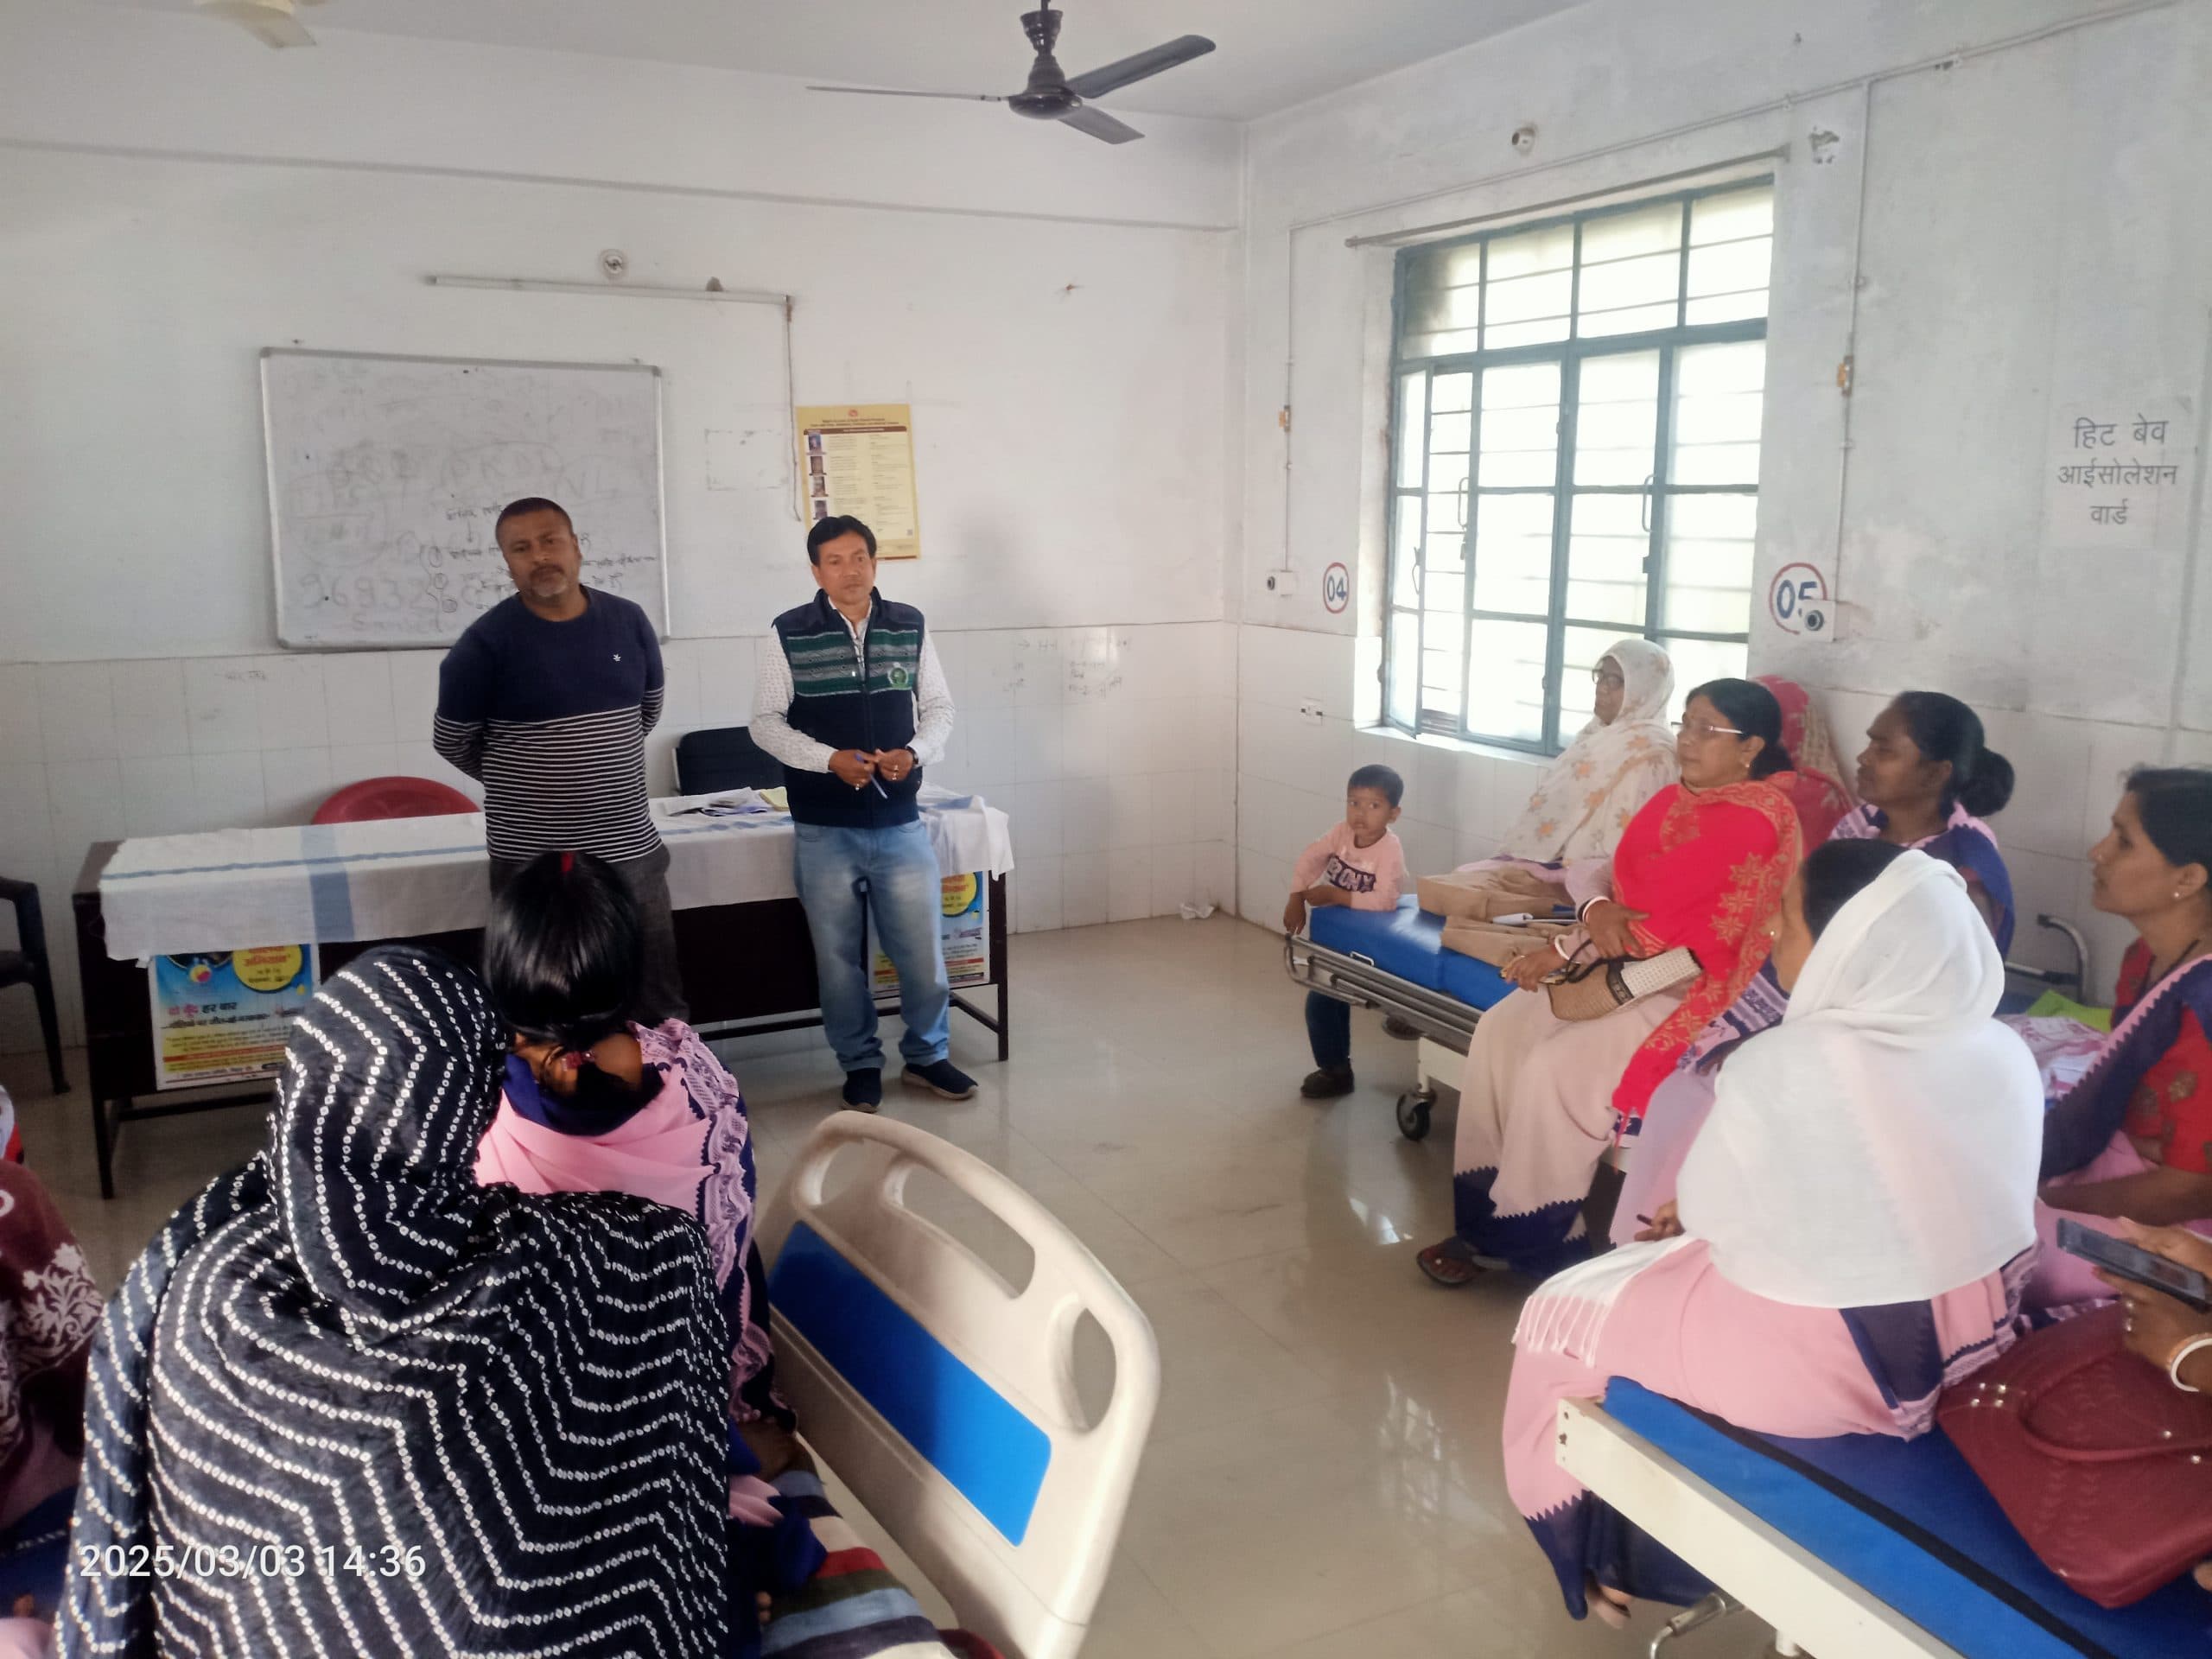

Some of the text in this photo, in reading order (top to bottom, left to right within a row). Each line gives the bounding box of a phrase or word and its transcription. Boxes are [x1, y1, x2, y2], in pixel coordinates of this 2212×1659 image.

[2072, 413, 2169, 449] हिट बेव
[2057, 457, 2178, 488] आईसोलेशन
[2089, 498, 2129, 524] वार्ड
[1327, 575, 1346, 602] 04
